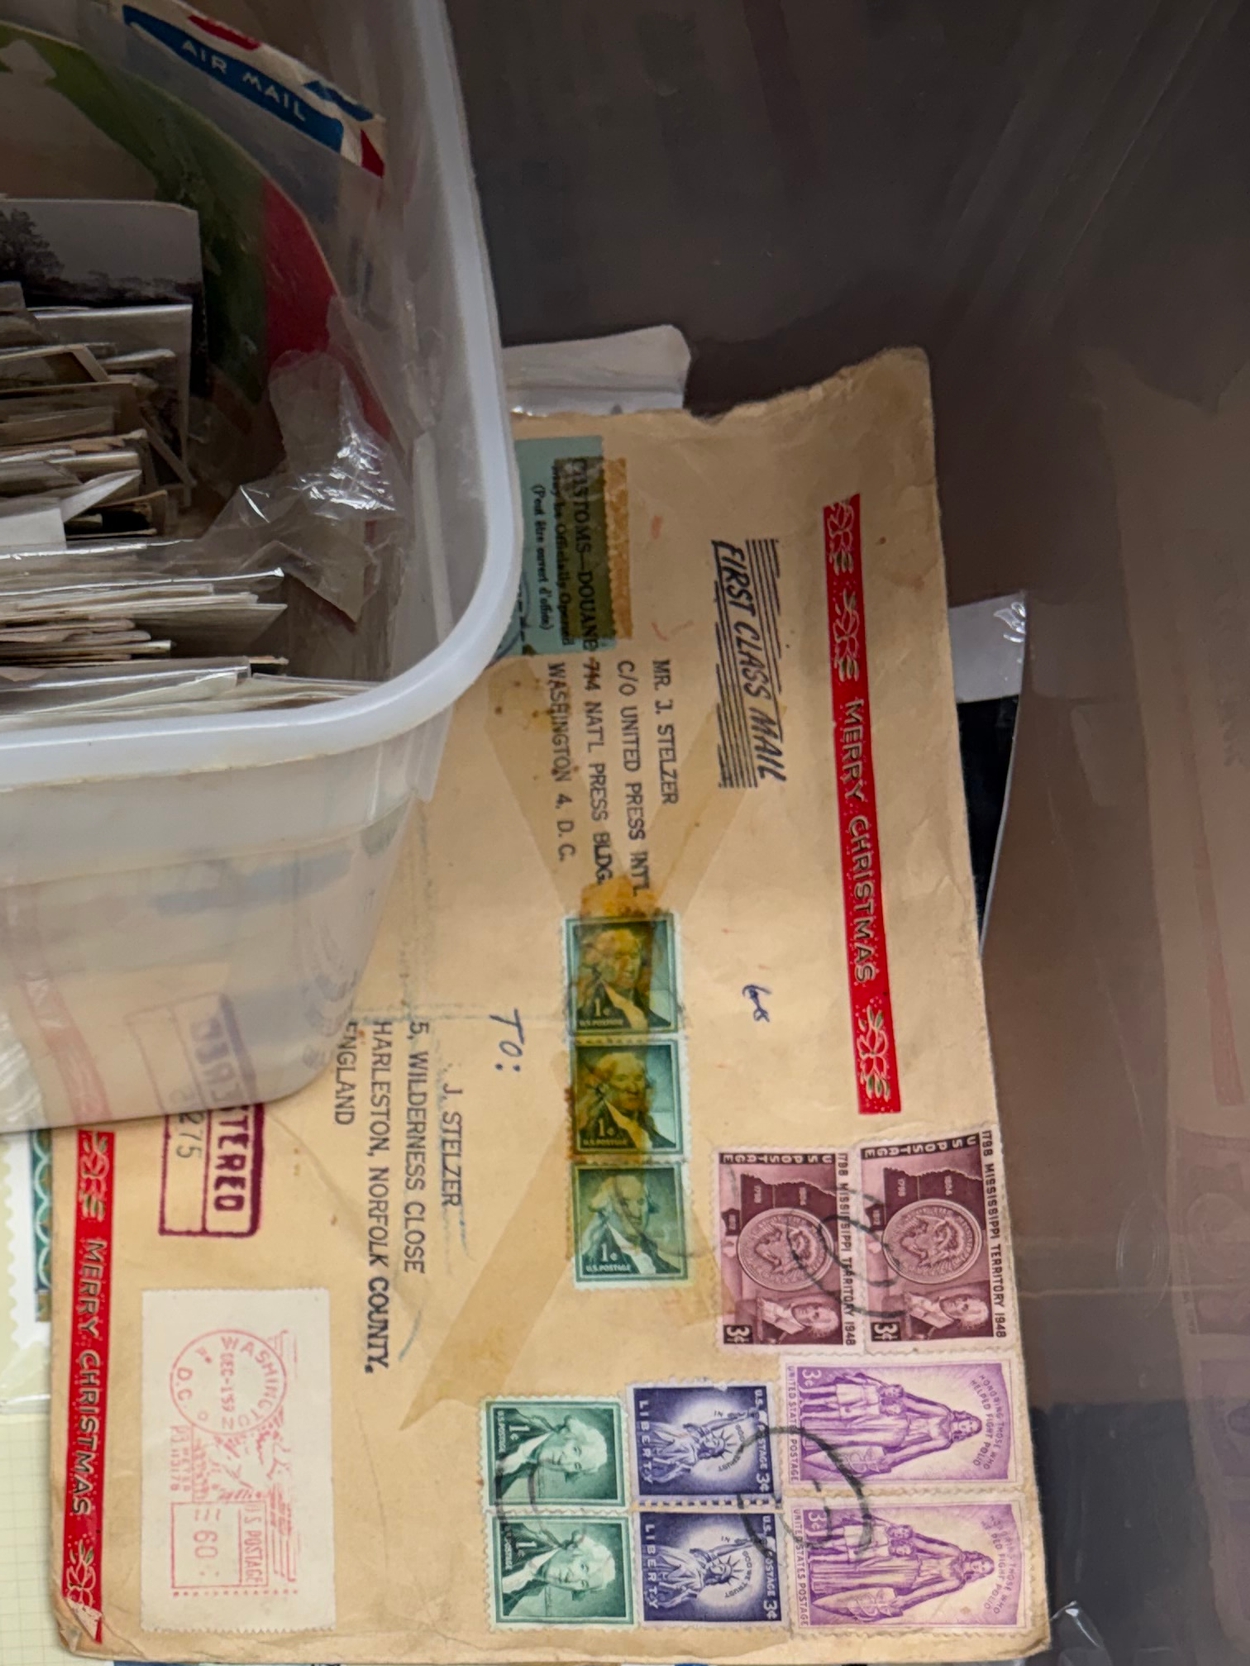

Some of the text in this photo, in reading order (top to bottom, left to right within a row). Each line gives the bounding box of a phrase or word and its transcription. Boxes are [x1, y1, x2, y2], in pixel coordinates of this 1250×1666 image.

[180, 40, 306, 122] AIR MAIL
[616, 660, 638, 696] C/O
[713, 540, 787, 783] FIRST CLASS MAIL
[618, 705, 642, 774] UNITED
[652, 660, 679, 806] MR. J. STELZER
[588, 761, 609, 822] PRESS
[624, 780, 646, 841] PRESS
[843, 698, 876, 984] MERRY CHRISTMAS
[333, 1020, 359, 1127] ENGLAND
[404, 1049, 430, 1193] WILDERNESS
[363, 1020, 394, 1375] HARLESTON, NORFOLK COUNTY.
[440, 1111, 464, 1209] STELZER
[402, 1201, 428, 1276] CLOSE
[981, 1130, 1008, 1339] 1798 MISSISSIPPI TERRITORY 1948
[70, 1240, 107, 1517] MERRY CHRISTMAS
[637, 1400, 655, 1485] LIBERTY
[644, 1523, 661, 1611] LIBERTY
